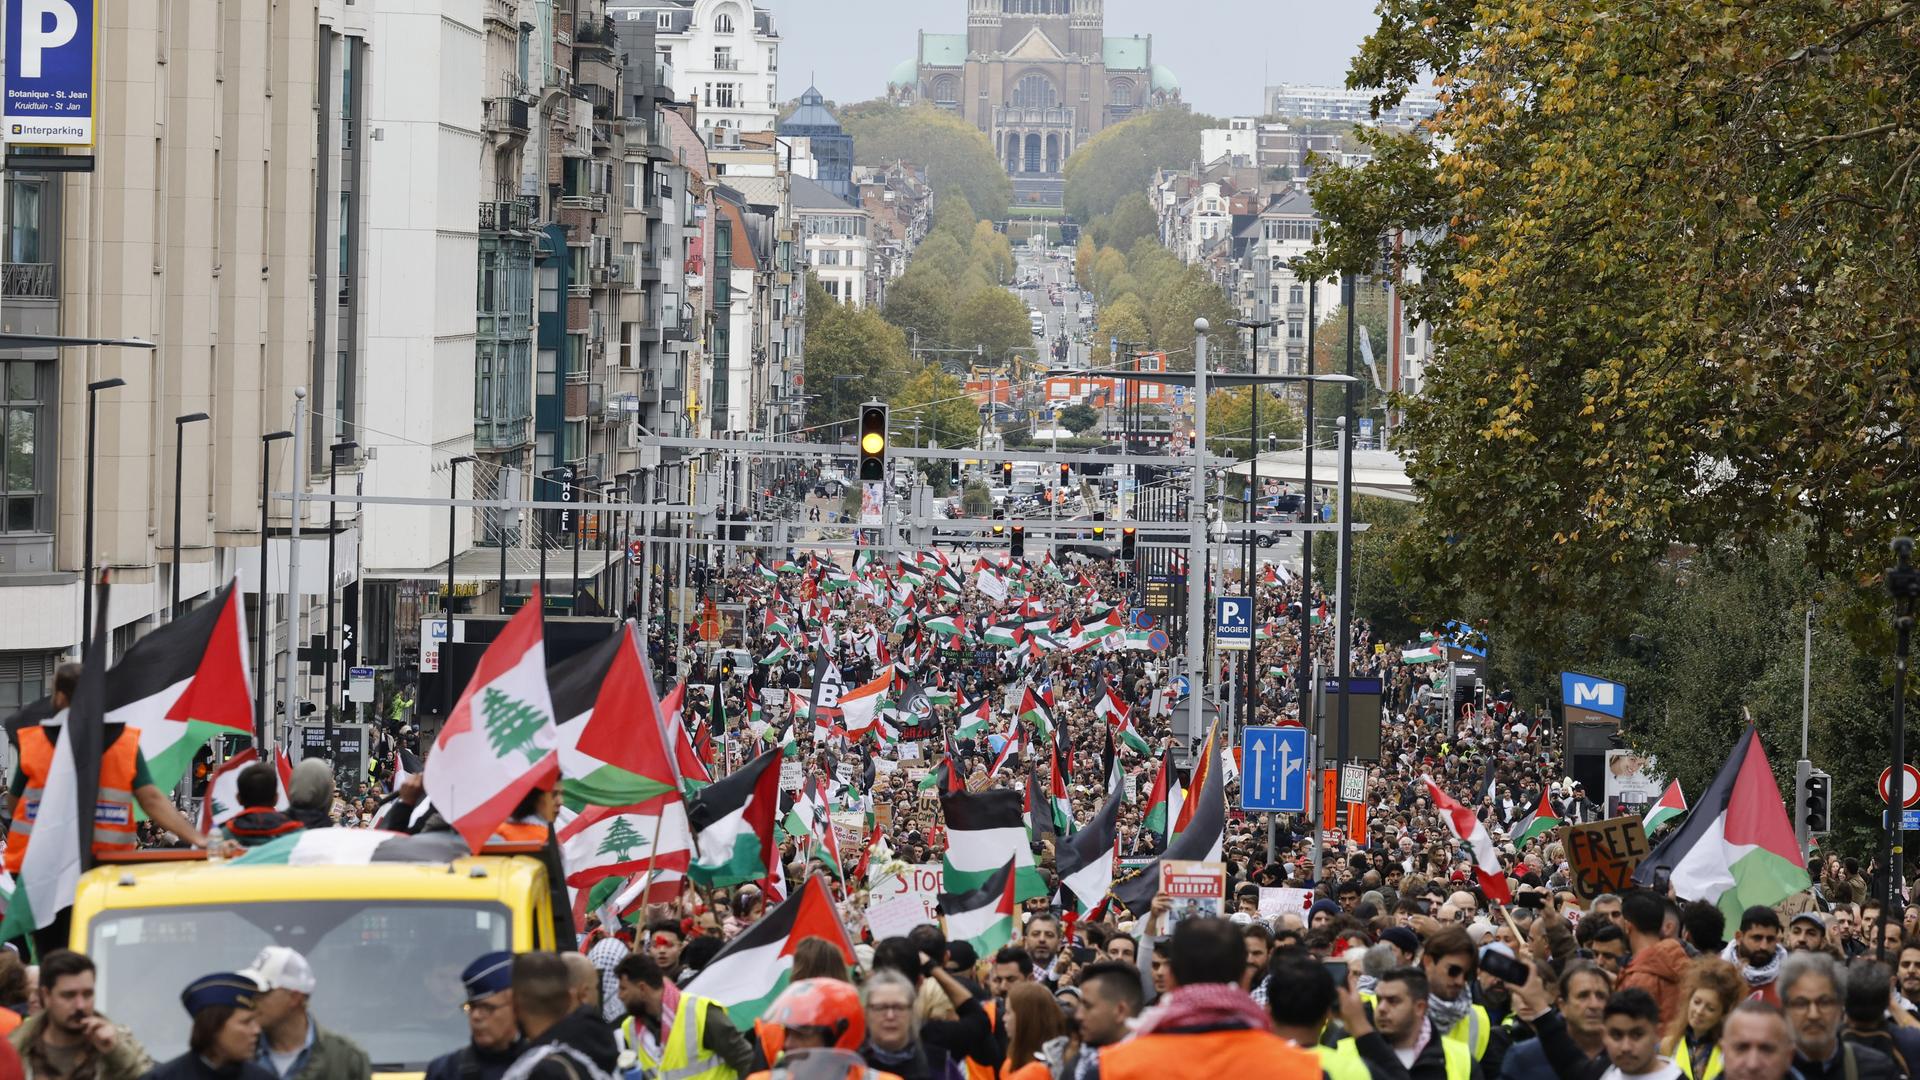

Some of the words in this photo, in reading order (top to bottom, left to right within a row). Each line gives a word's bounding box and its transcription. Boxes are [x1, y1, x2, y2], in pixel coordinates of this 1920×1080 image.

[20, 0, 78, 78] P
[8, 90, 49, 99] Botanique
[55, 91, 67, 99] St.
[68, 91, 88, 99] Jean
[15, 101, 48, 110] Kruidtuin
[54, 102, 63, 110] St
[23, 126, 84, 137] Interparking
[562, 482, 571, 531] HOEL
[1222, 602, 1239, 625] P
[1574, 682, 1614, 705] M
[1346, 768, 1363, 779] STOP
[1345, 778, 1363, 788] GENO
[1344, 787, 1361, 799] CIDE
[1568, 822, 1638, 866] FREE
[1576, 859, 1641, 900] GAZ
[1168, 881, 1219, 895] KIDNAPPÉ
[1567, 911, 1580, 921] St
